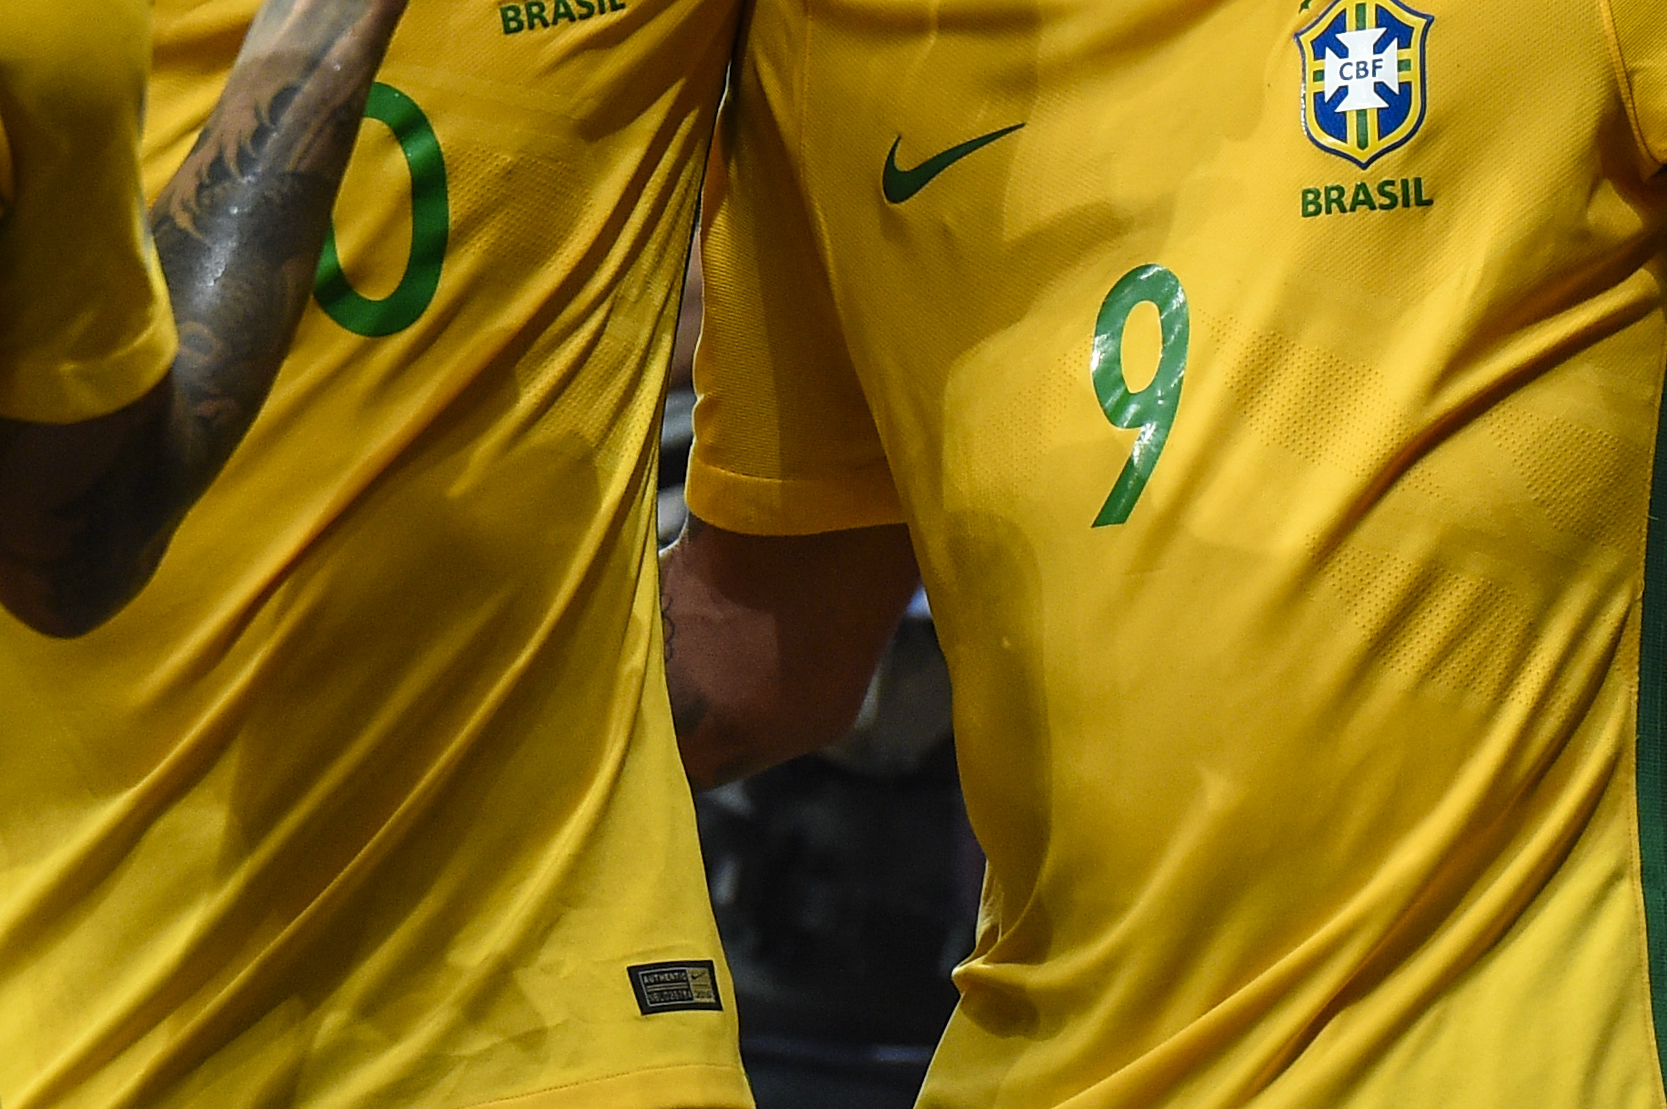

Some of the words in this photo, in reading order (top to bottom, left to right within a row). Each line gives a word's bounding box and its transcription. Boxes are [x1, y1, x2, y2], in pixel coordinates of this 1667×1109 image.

[1339, 58, 1383, 81] CBF
[1301, 177, 1434, 218] BRASIL
[1091, 263, 1190, 528] 9
[644, 972, 687, 983] AUTHENTIC
